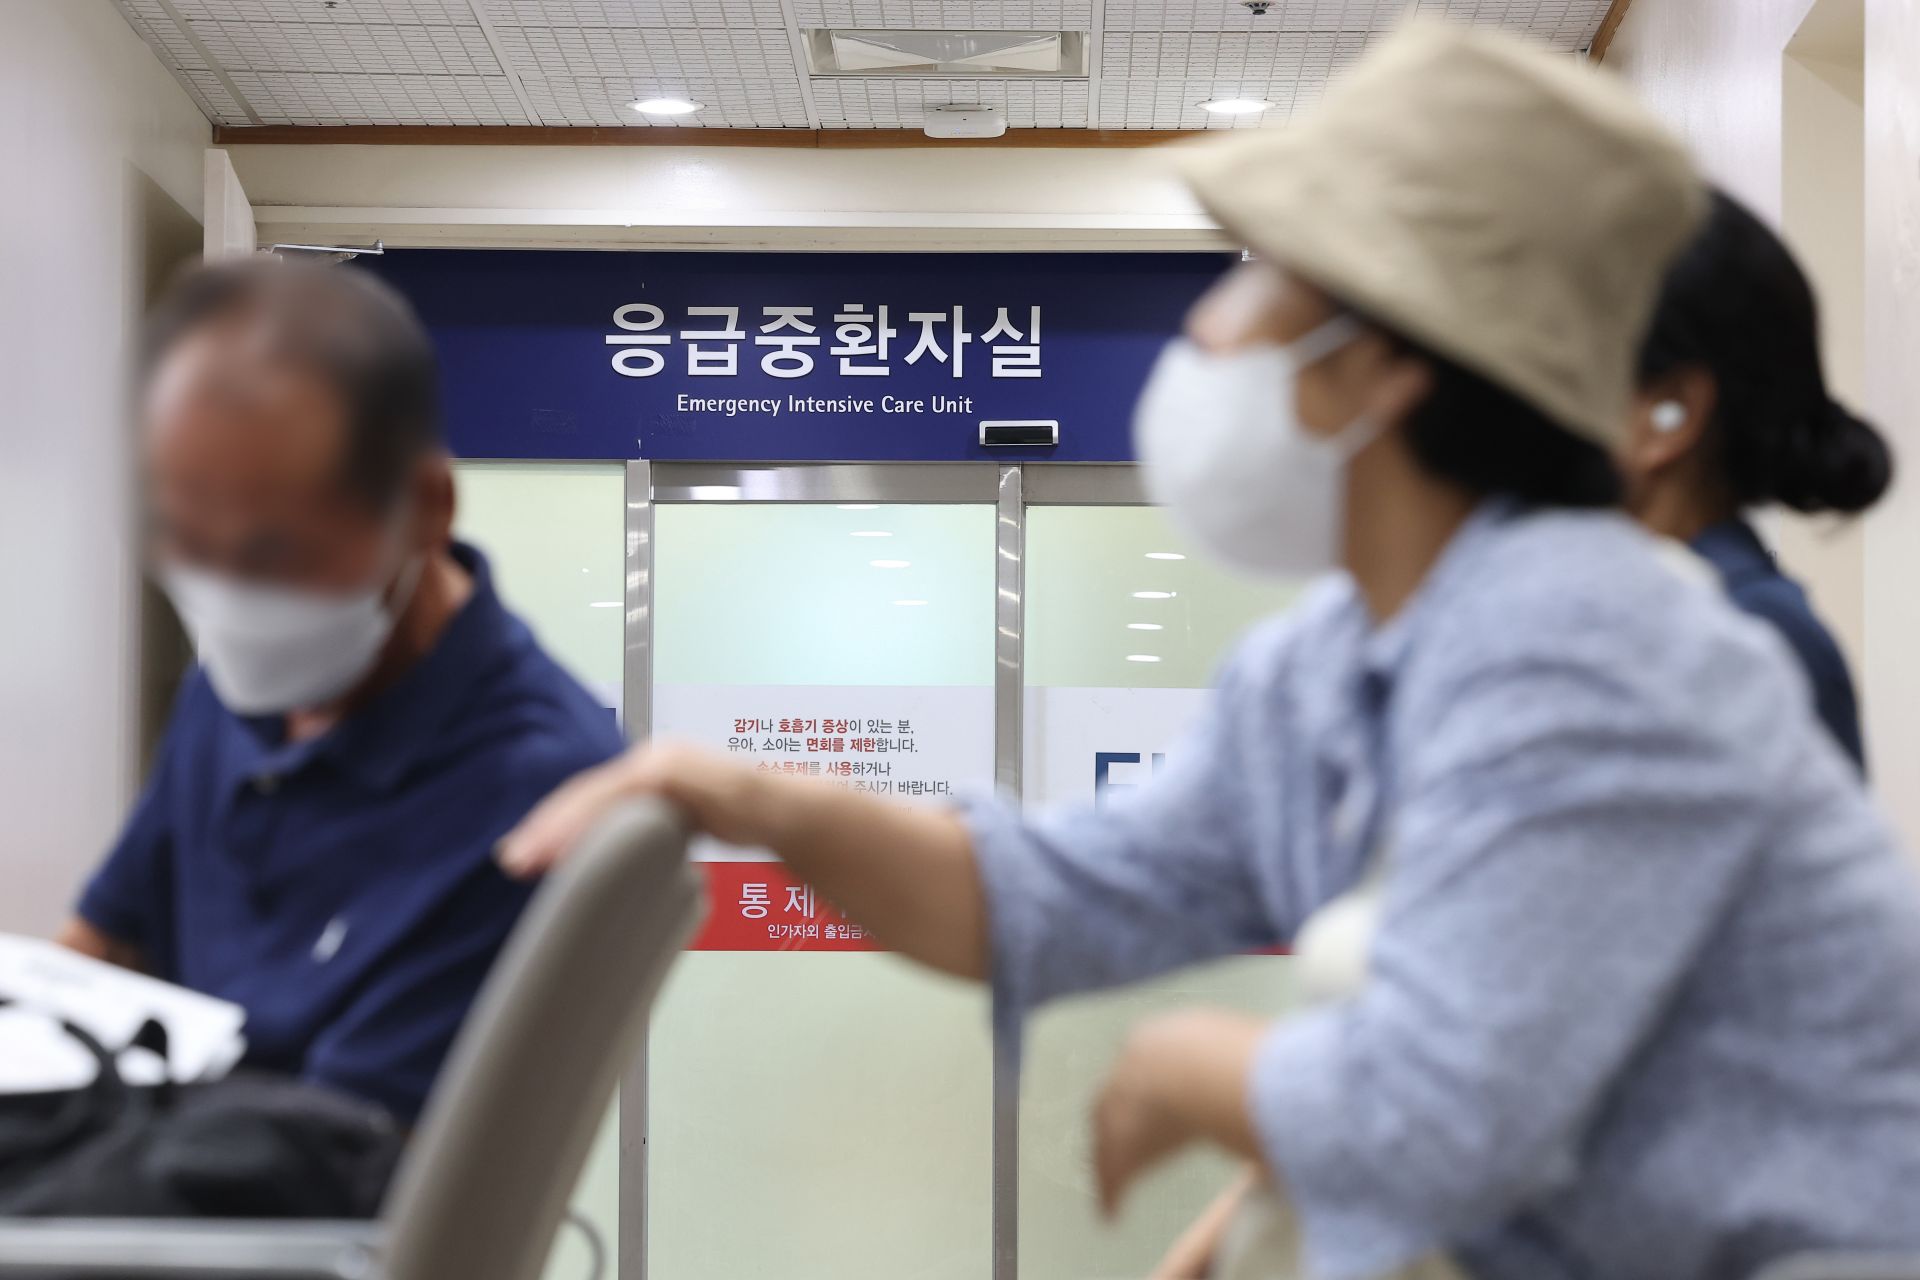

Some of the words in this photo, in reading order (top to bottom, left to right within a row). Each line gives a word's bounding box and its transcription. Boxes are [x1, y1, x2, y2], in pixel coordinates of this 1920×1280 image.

[603, 302, 1045, 379] 응급중환자실
[676, 394, 781, 417] Emergency
[788, 393, 874, 414] Intensive
[881, 394, 924, 414] Care
[931, 393, 973, 414] Unit
[734, 718, 774, 734] 감기나
[778, 718, 817, 734] 호흡기
[822, 719, 862, 734] 증상이
[867, 718, 893, 734] 있는
[727, 737, 757, 753] 유아,
[762, 737, 801, 752] 소아는
[806, 737, 845, 753] 면회를
[850, 737, 918, 753] 제한합니다.
[826, 760, 891, 776] 사용하거나
[854, 780, 893, 796] 주시기
[898, 780, 953, 796] 바랍니다.
[767, 924, 820, 939] 인가자외
